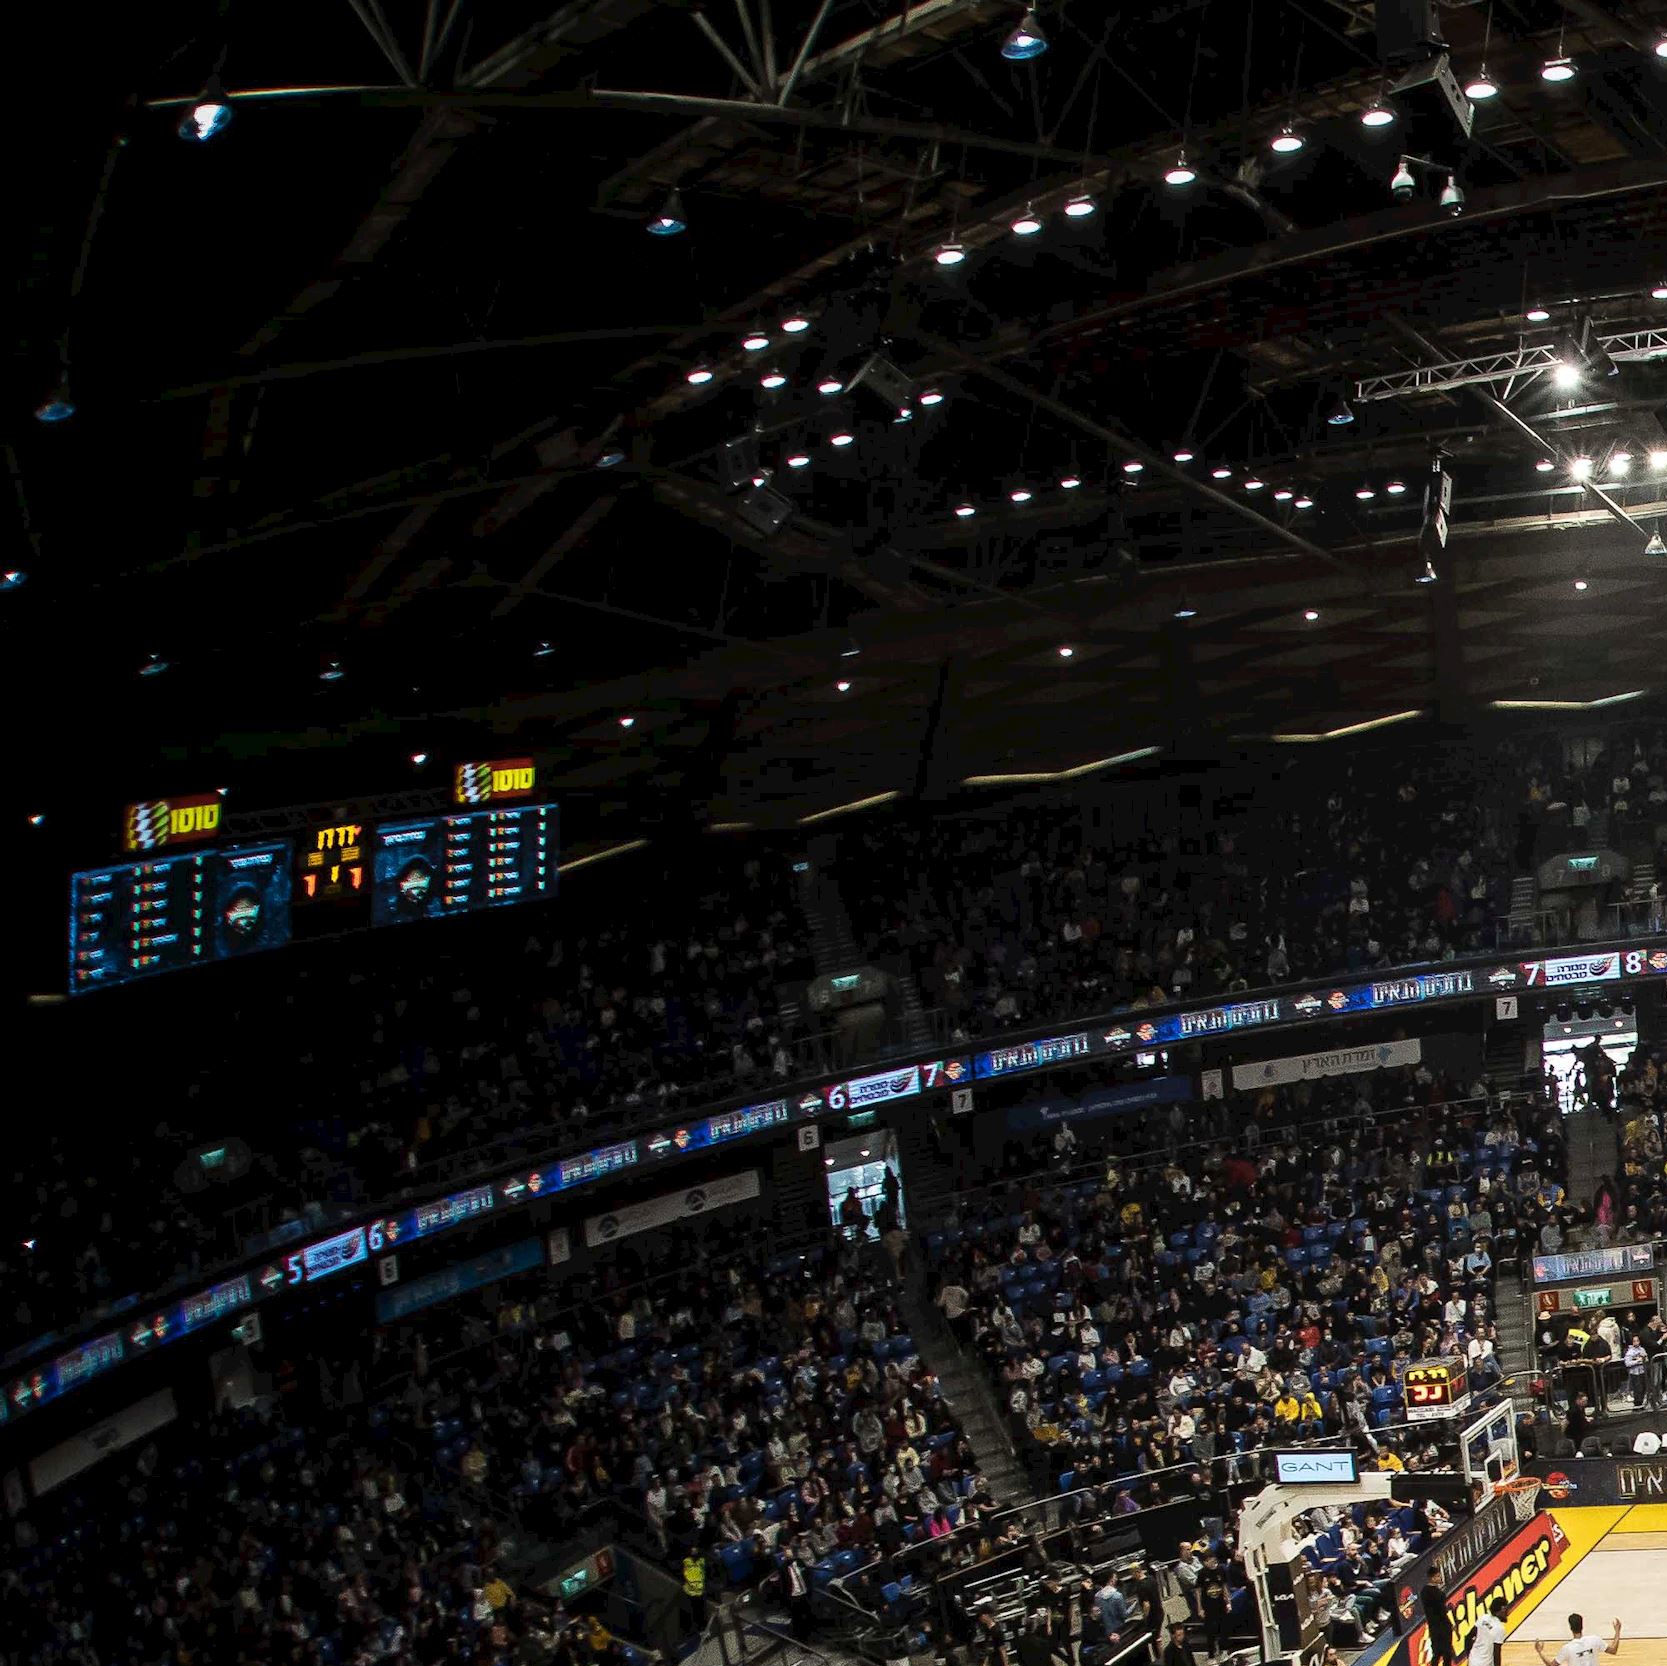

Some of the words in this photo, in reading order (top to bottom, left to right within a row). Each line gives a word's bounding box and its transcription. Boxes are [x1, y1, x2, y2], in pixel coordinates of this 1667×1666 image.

[1626, 952, 1642, 974] 8
[1525, 964, 1540, 986] 7
[1502, 1001, 1511, 1015] 7
[923, 1061, 943, 1088] 7
[828, 1085, 846, 1109] 6
[1281, 1461, 1349, 1473] GANT
